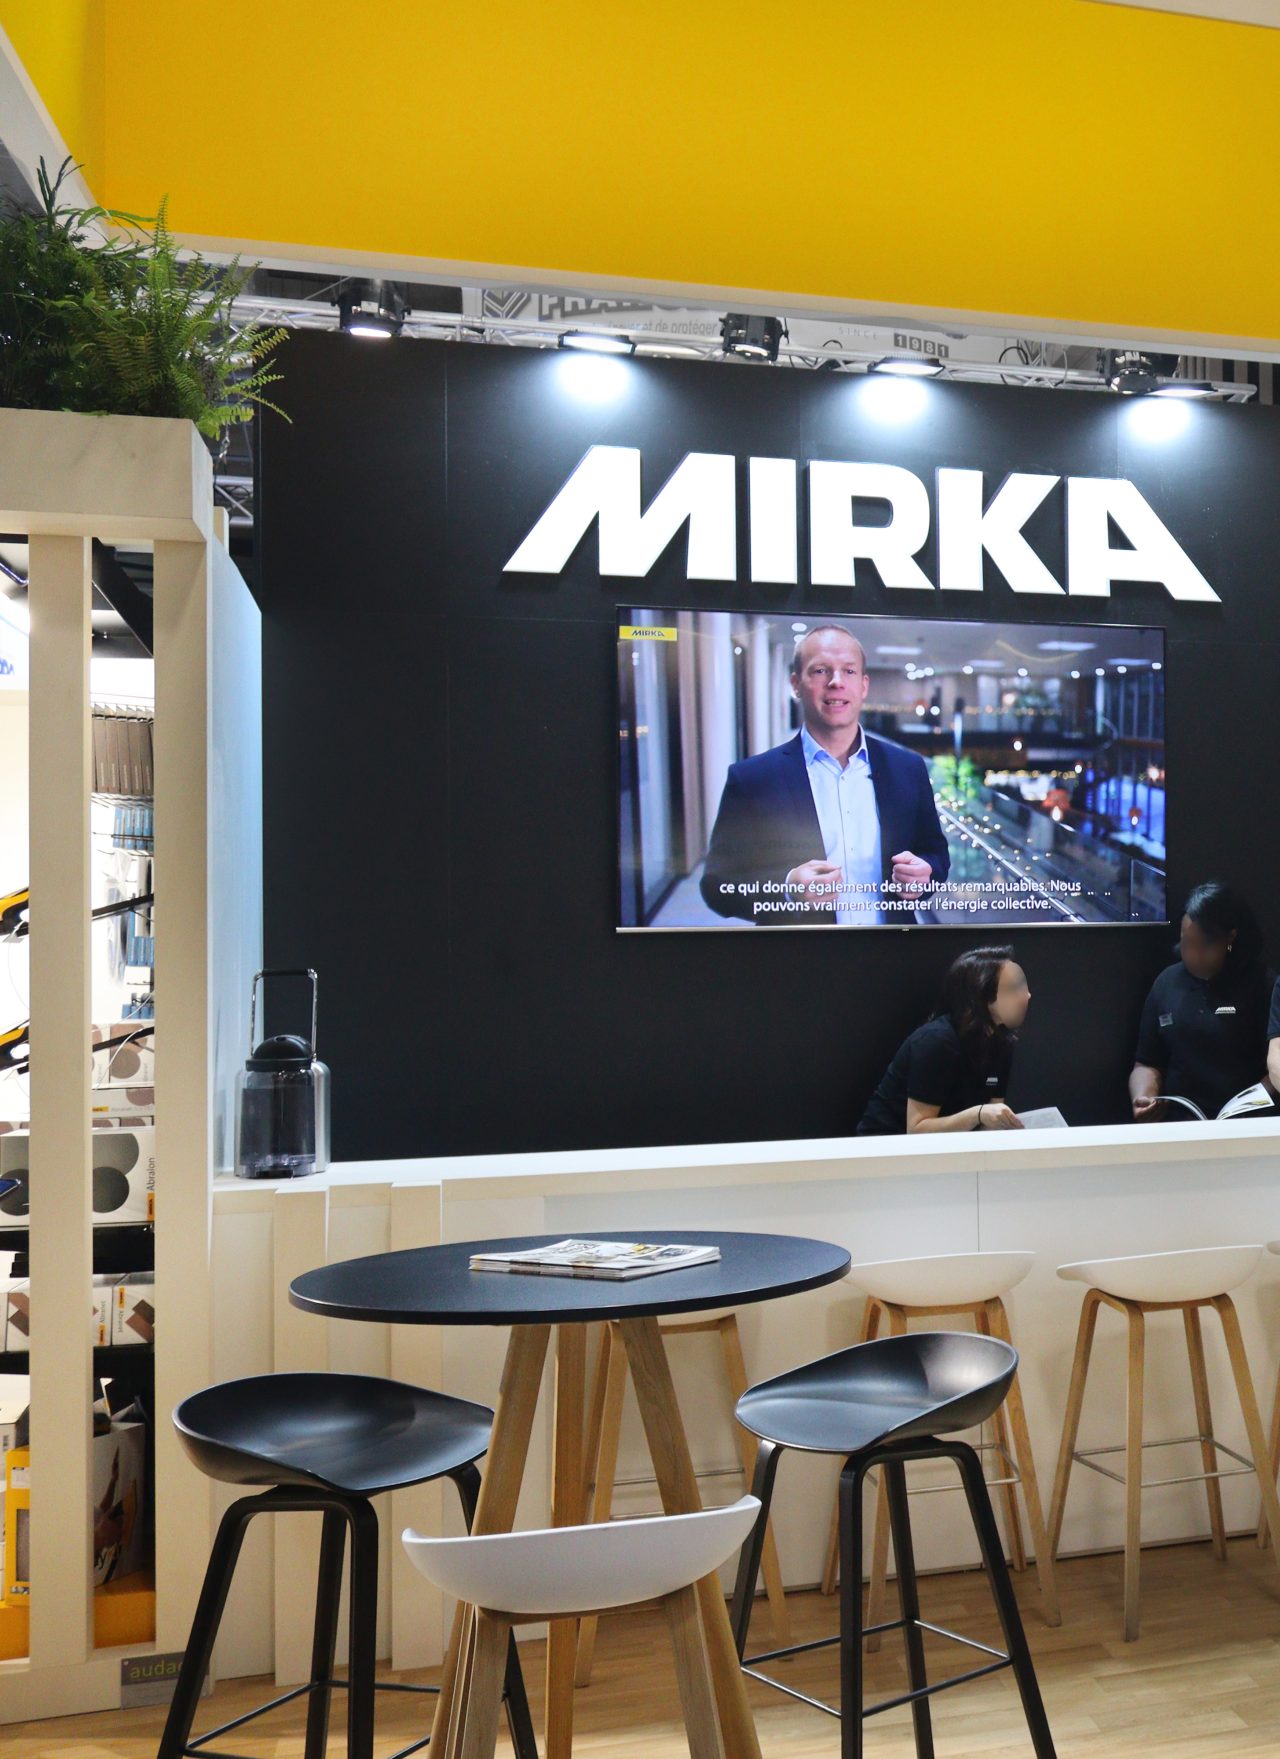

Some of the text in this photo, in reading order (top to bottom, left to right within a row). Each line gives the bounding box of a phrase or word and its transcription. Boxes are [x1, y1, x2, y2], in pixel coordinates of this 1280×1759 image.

[655, 319, 668, 332] de
[671, 319, 718, 337] protéger
[839, 326, 948, 357] SINCE 1981
[502, 445, 1222, 602] MIRKA
[719, 879, 1081, 896] ce qui donne également des résultats remarquables. Nous
[753, 897, 1052, 914] pouvons vraiment constater l'énergie collective.
